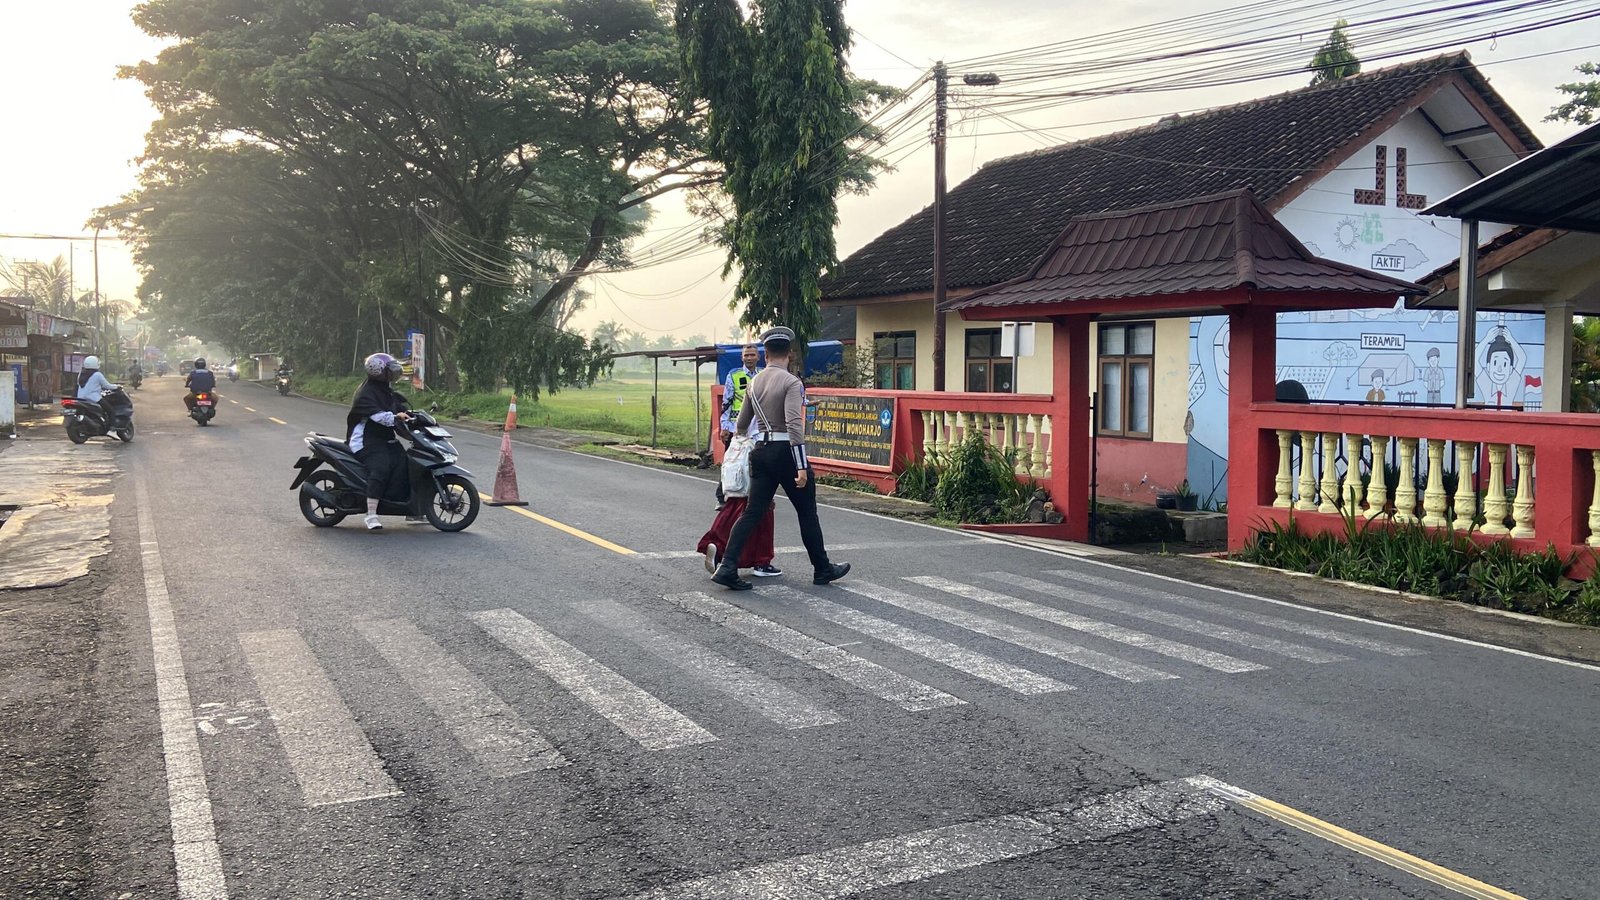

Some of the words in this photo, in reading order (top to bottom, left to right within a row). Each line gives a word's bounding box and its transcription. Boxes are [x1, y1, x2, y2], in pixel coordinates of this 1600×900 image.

[1375, 257, 1402, 268] AKTIF
[1363, 336, 1402, 346] TERAMPIL
[814, 420, 822, 431] SD
[822, 421, 841, 433] NEGERI
[846, 423, 882, 437] WONOHARJO
